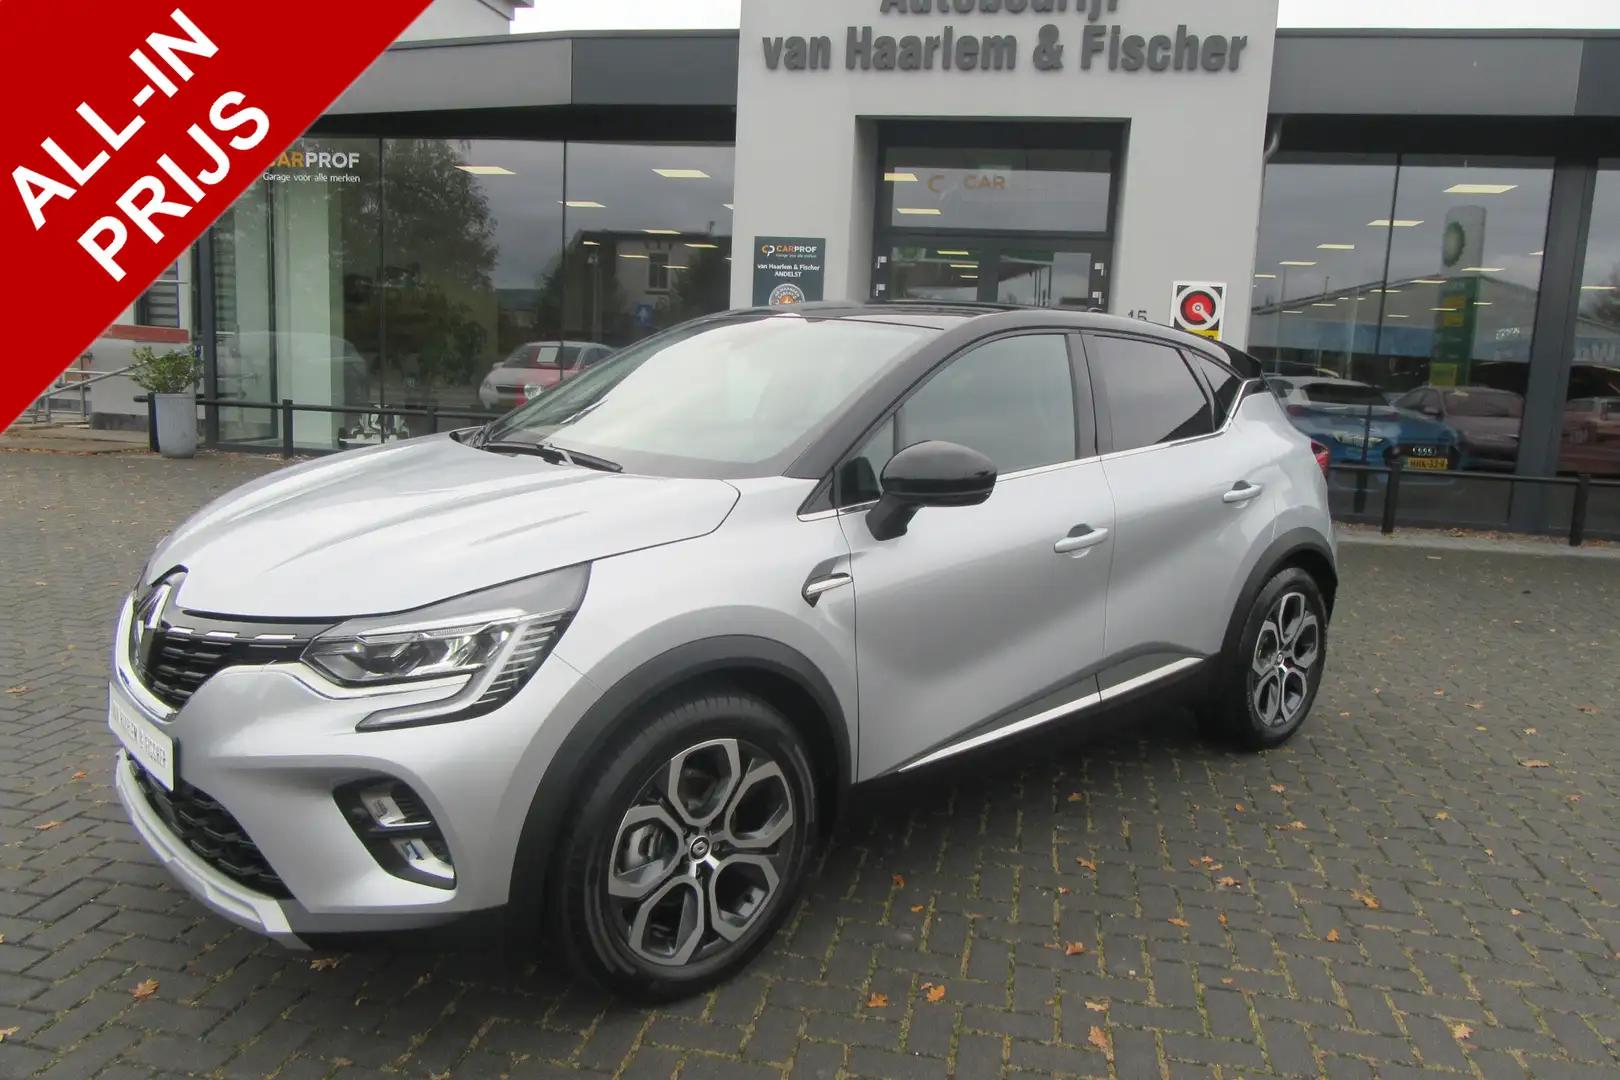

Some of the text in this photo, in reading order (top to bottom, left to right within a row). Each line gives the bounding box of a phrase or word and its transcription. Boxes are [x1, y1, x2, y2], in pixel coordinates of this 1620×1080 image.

[763, 24, 1247, 73] van Haarlem & Fischer
[262, 172, 360, 183] Garage voor alle merken
[776, 245, 817, 253] CARPROF
